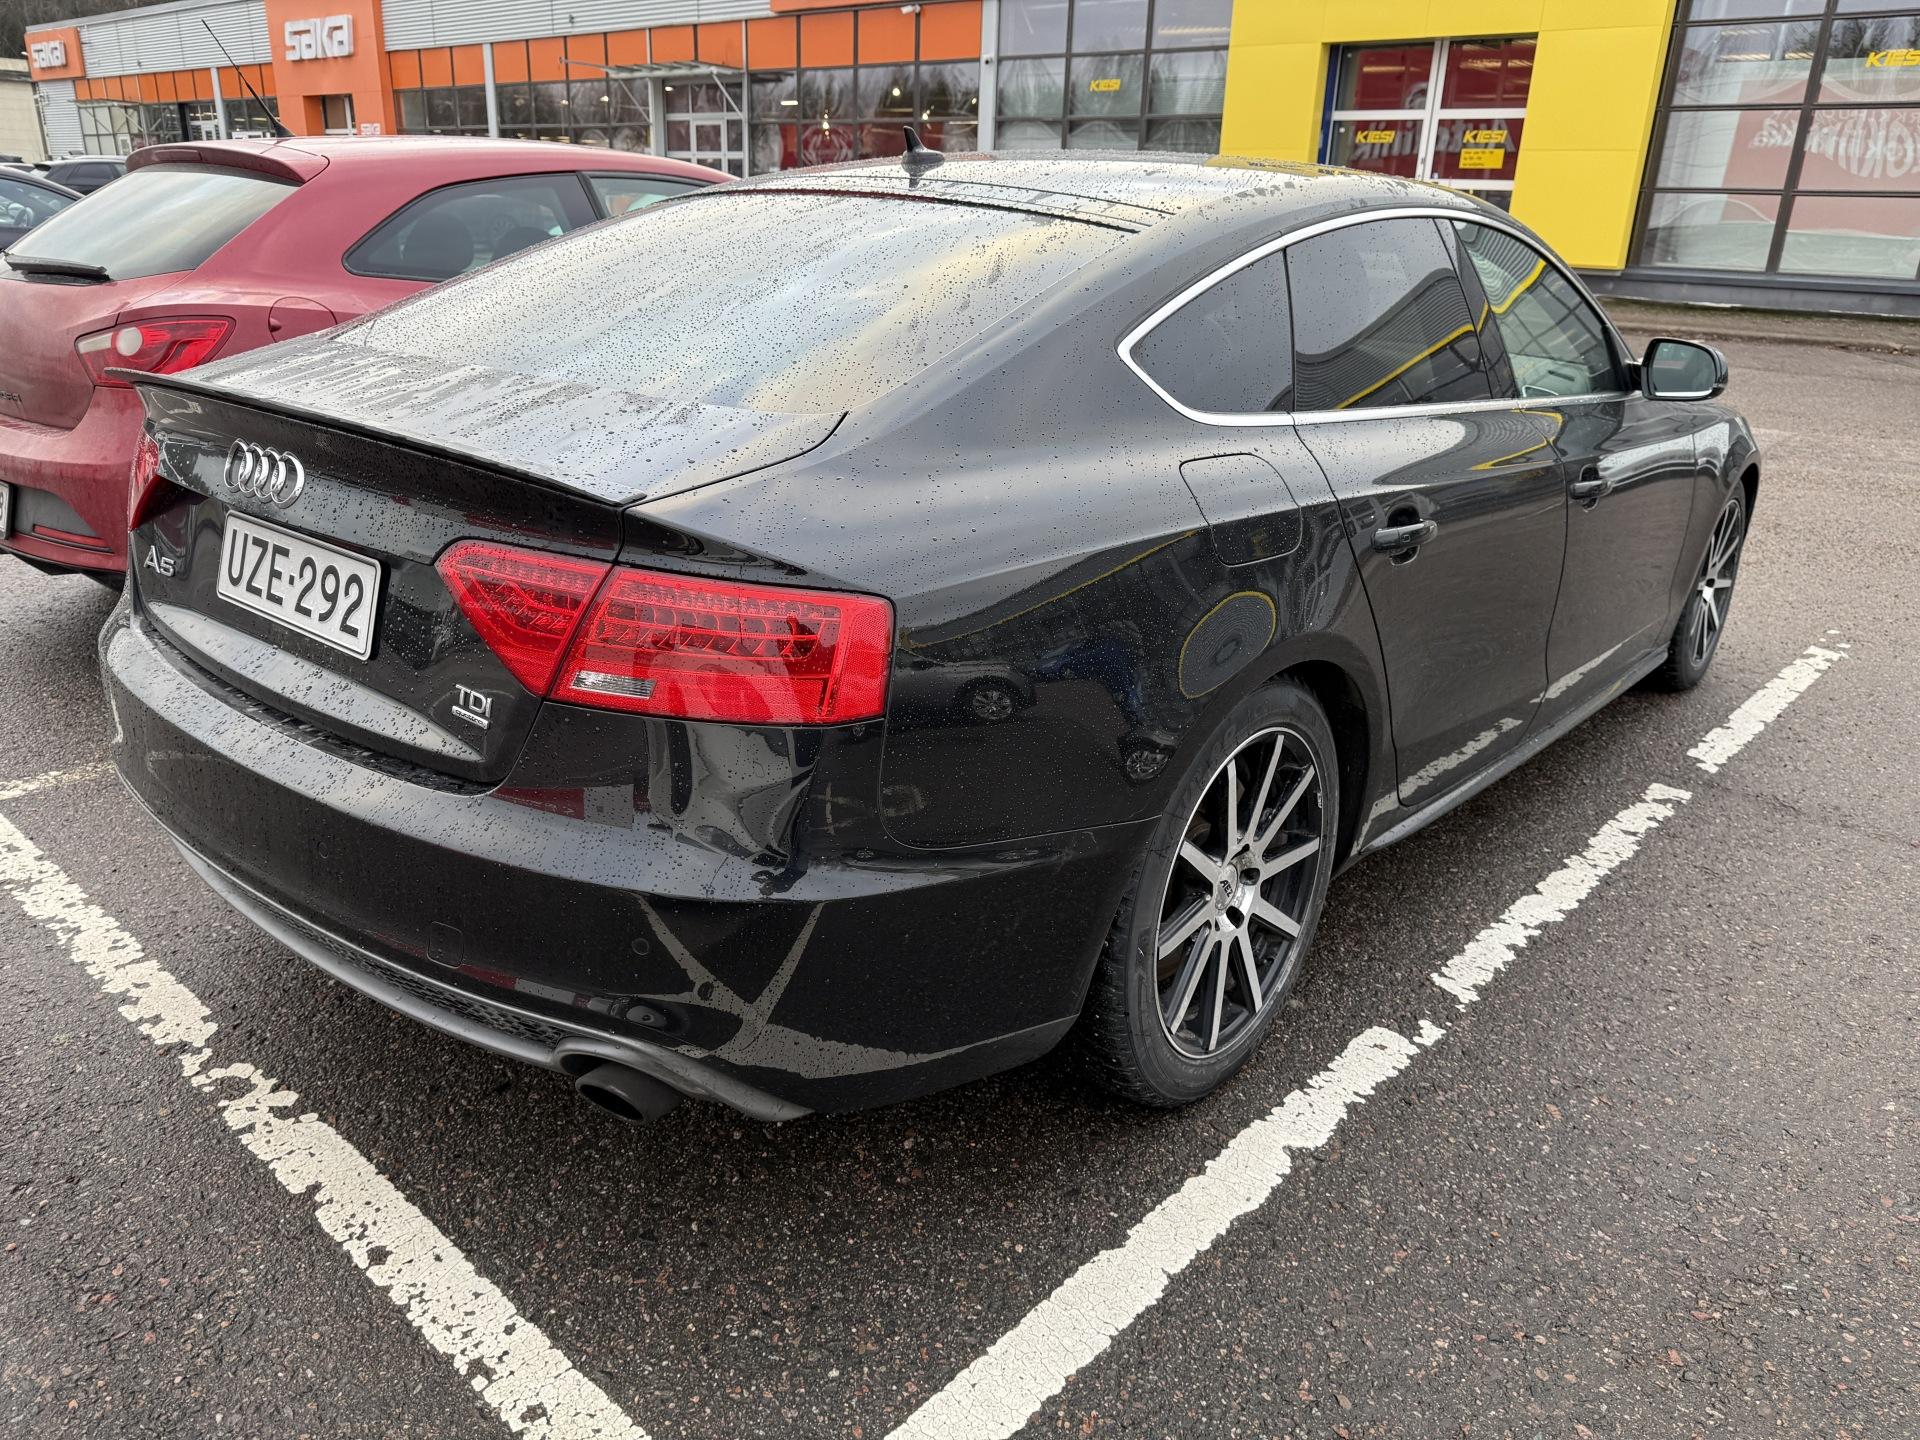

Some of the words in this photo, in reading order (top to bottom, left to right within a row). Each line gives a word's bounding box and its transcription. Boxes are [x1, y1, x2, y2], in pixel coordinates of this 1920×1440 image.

[1089, 79, 1121, 92] KIESI
[1355, 130, 1396, 144] KIESI
[1462, 130, 1508, 144] KIESI
[143, 545, 175, 577] A5
[228, 528, 364, 638] UZE-292
[455, 684, 492, 718] TDI
